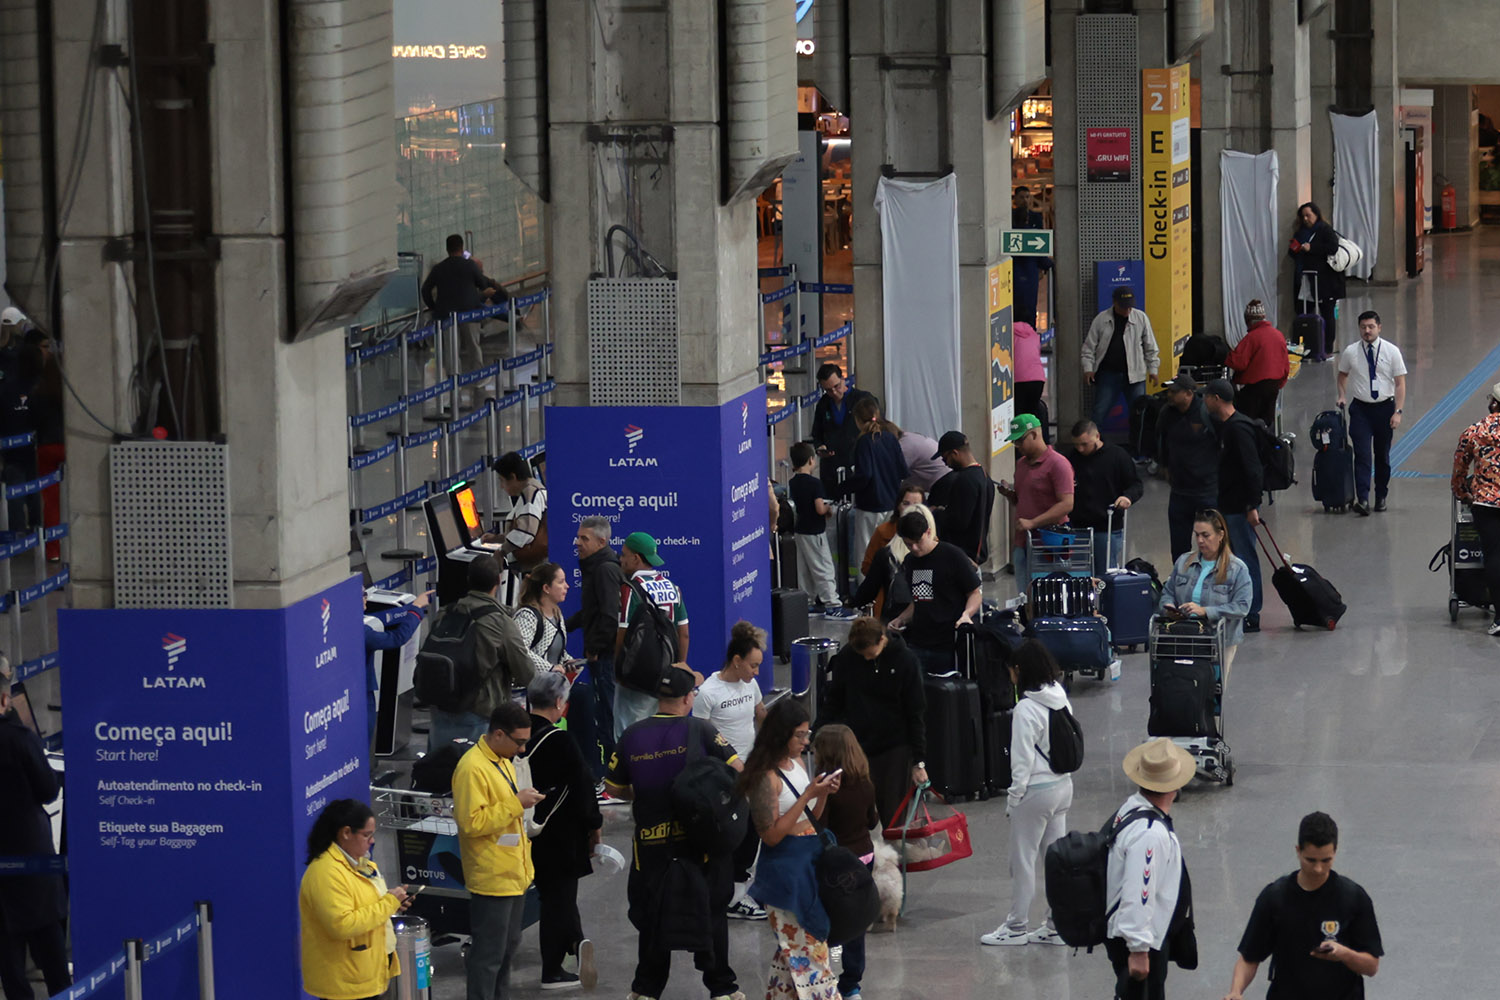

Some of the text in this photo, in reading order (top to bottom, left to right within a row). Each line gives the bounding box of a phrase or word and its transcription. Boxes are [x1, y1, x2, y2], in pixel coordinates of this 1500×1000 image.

[1151, 92, 1163, 110] 2
[1151, 131, 1163, 153] E
[1149, 170, 1166, 260] Check-in
[609, 458, 658, 466] LATAM
[572, 492, 678, 511] Começa aqui!
[664, 537, 700, 545] check-in
[646, 581, 672, 592] AME
[658, 591, 676, 601] RIO
[315, 646, 337, 668] LATAM
[142, 677, 206, 688] LATAM
[721, 695, 752, 709] GROWTH
[304, 689, 350, 734] Começa aqui!
[95, 722, 232, 746] Começa aqui!
[96, 749, 158, 761] Start here!
[98, 780, 262, 791] Autoatendimento no check-in
[99, 795, 155, 807] Self Check-in
[99, 822, 223, 836] Etiquete sua Bagagem
[138, 838, 156, 848] your
